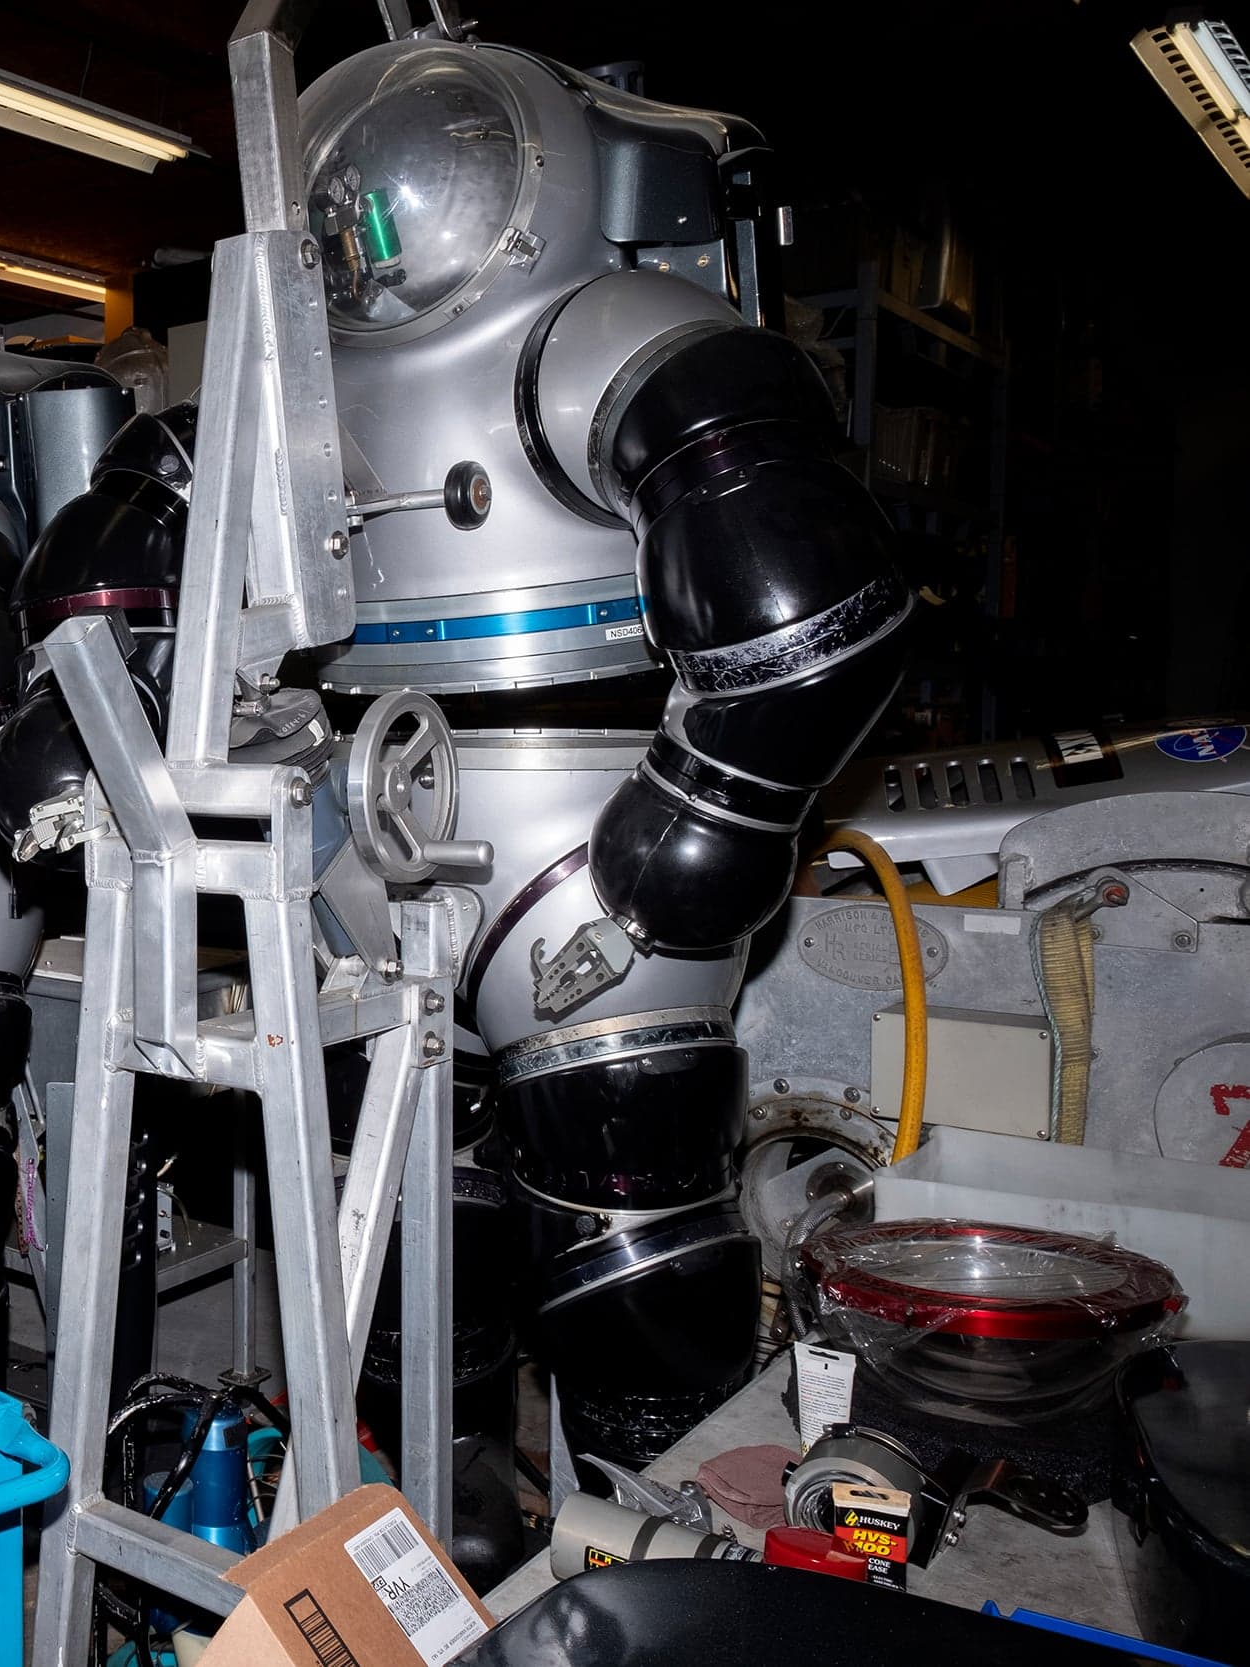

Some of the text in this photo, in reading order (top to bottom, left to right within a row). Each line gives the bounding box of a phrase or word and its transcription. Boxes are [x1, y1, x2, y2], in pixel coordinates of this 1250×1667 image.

[859, 1515, 901, 1531] HUSKEY
[853, 1528, 898, 1546] HVS-
[867, 1557, 891, 1569] CONE
[867, 1563, 889, 1575] EASE
[383, 1576, 411, 1600] YVR
